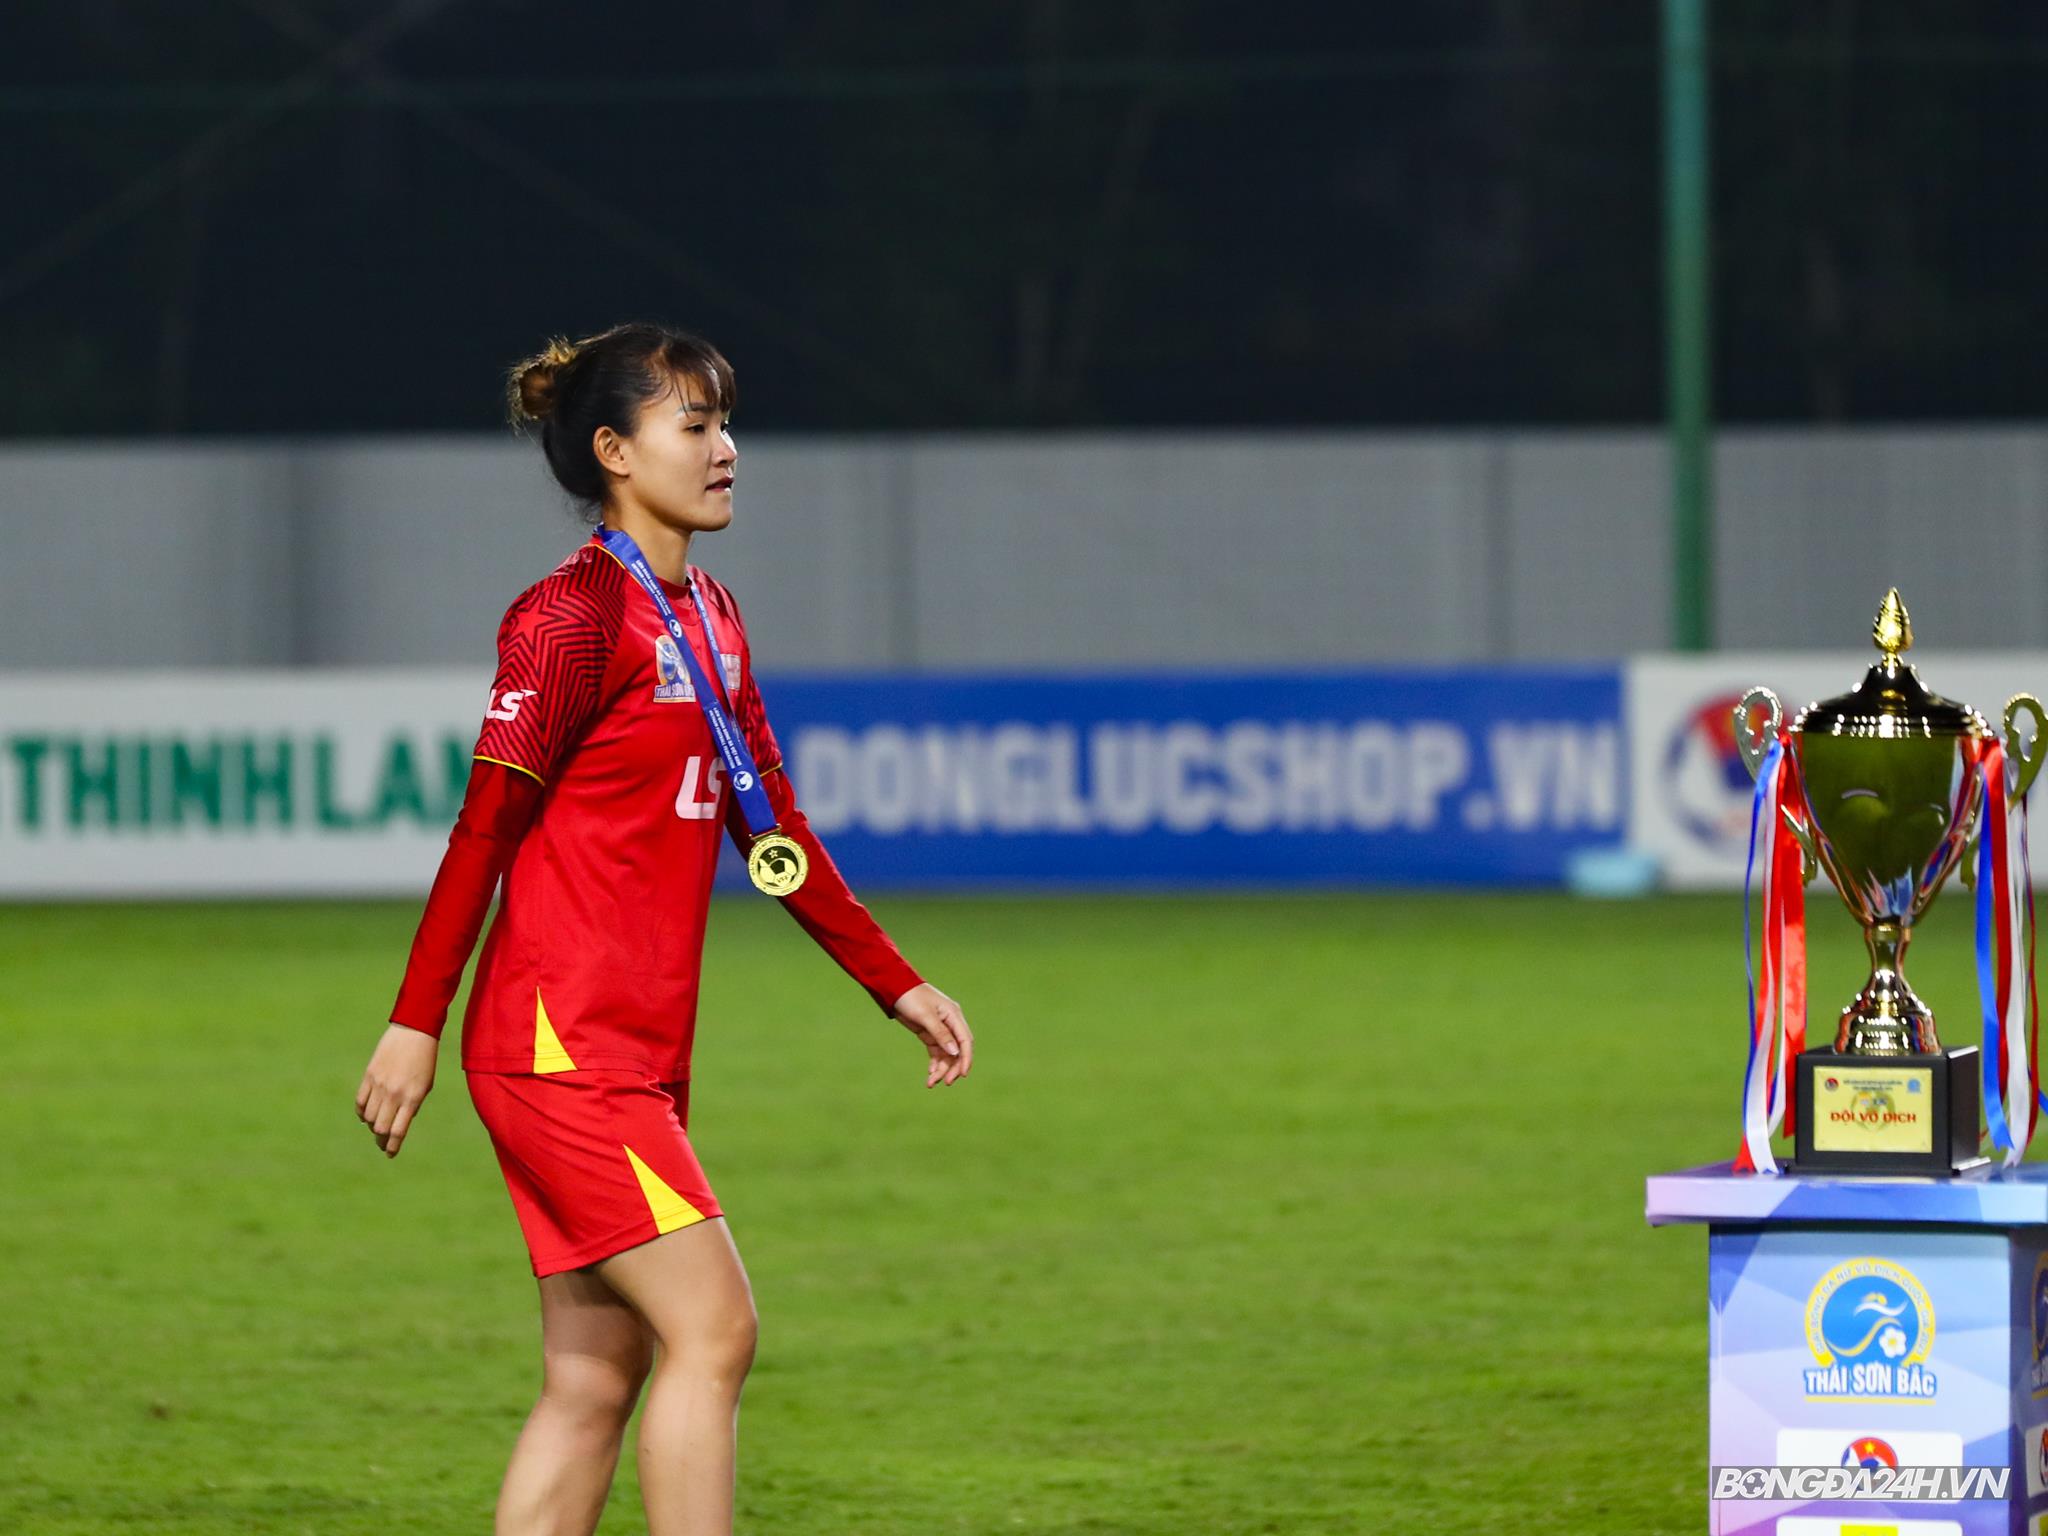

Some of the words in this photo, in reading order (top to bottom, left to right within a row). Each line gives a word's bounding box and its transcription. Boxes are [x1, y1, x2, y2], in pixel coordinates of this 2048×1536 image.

[486, 688, 524, 721] LS
[795, 721, 1618, 833] DONGLUCSHOP.VN
[1806, 1363, 1848, 1393] THÁI
[1852, 1361, 1891, 1394] SƠN
[1897, 1364, 1935, 1396] BẮC
